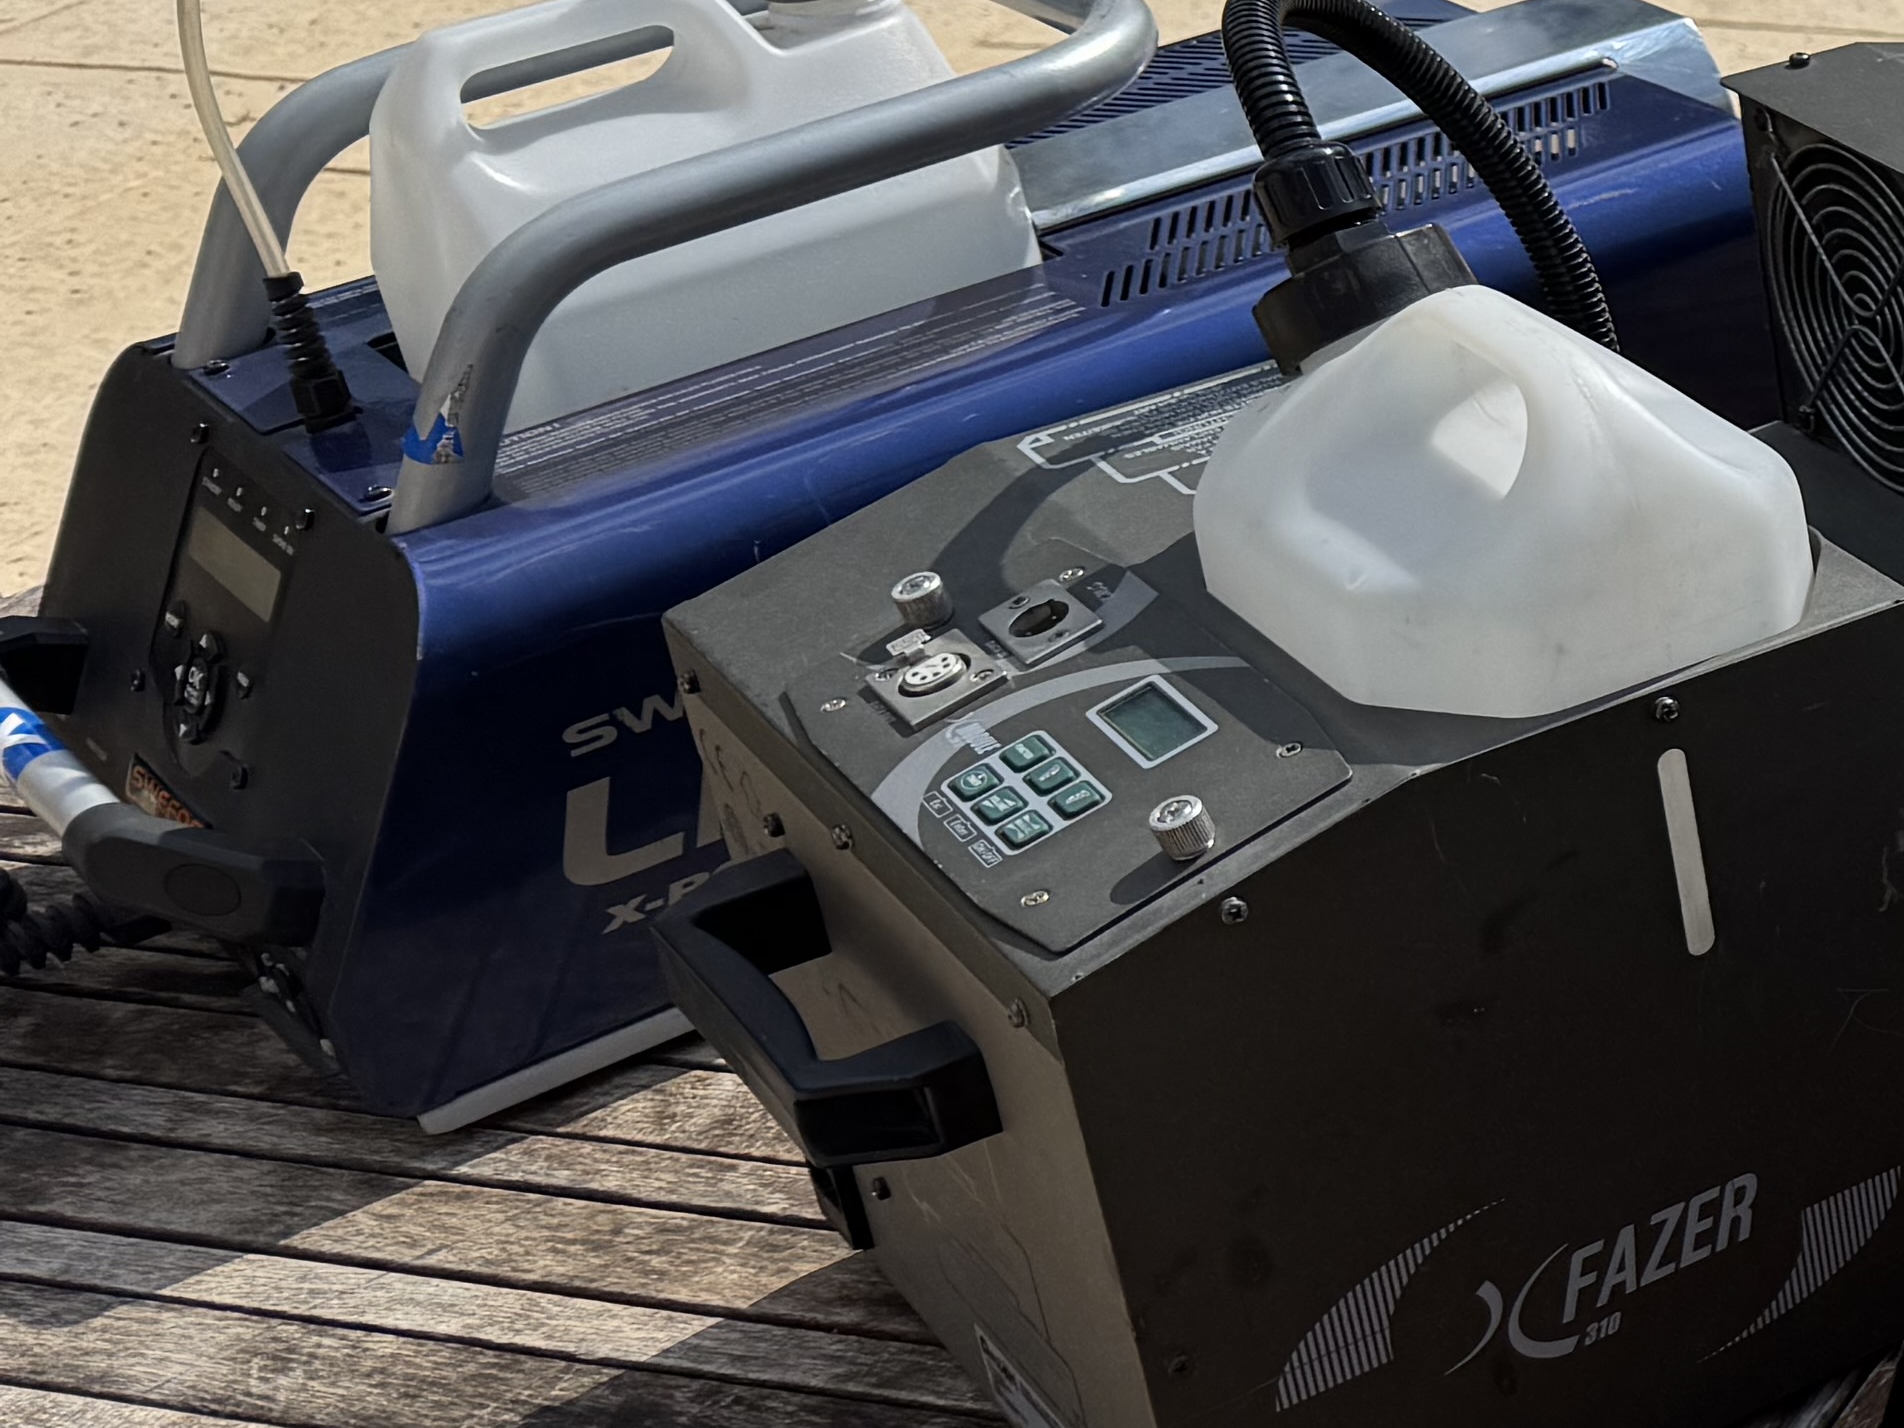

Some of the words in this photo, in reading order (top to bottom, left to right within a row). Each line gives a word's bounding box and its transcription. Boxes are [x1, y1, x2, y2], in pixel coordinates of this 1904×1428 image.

[562, 692, 684, 759] SW
[601, 871, 735, 935] X-P
[1563, 1172, 1758, 1323] FAZER
[1583, 1311, 1622, 1347] 310
